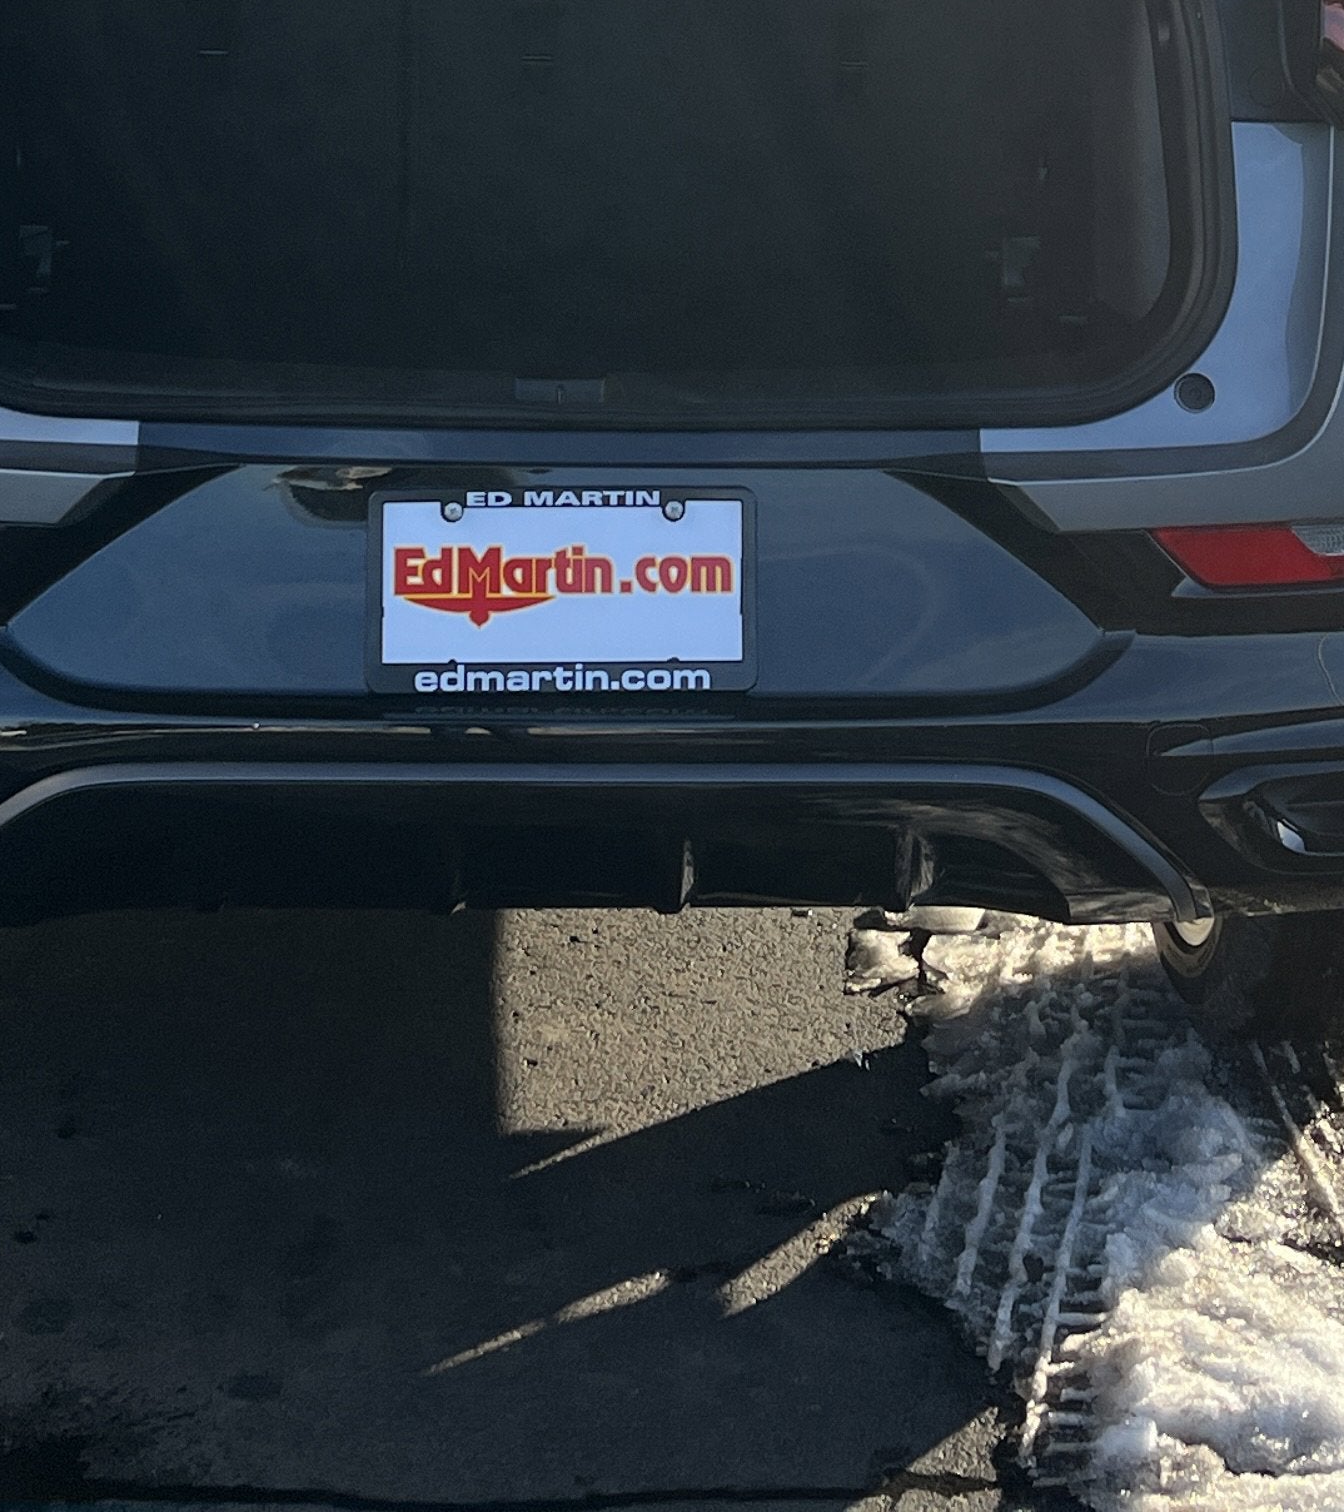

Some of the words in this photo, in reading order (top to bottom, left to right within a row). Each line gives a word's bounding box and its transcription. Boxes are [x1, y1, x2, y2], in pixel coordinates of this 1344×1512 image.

[467, 492, 512, 507] ED
[524, 490, 660, 506] MARTIN
[394, 545, 732, 595] EdMartin.com
[414, 664, 711, 692] edmartin.com
